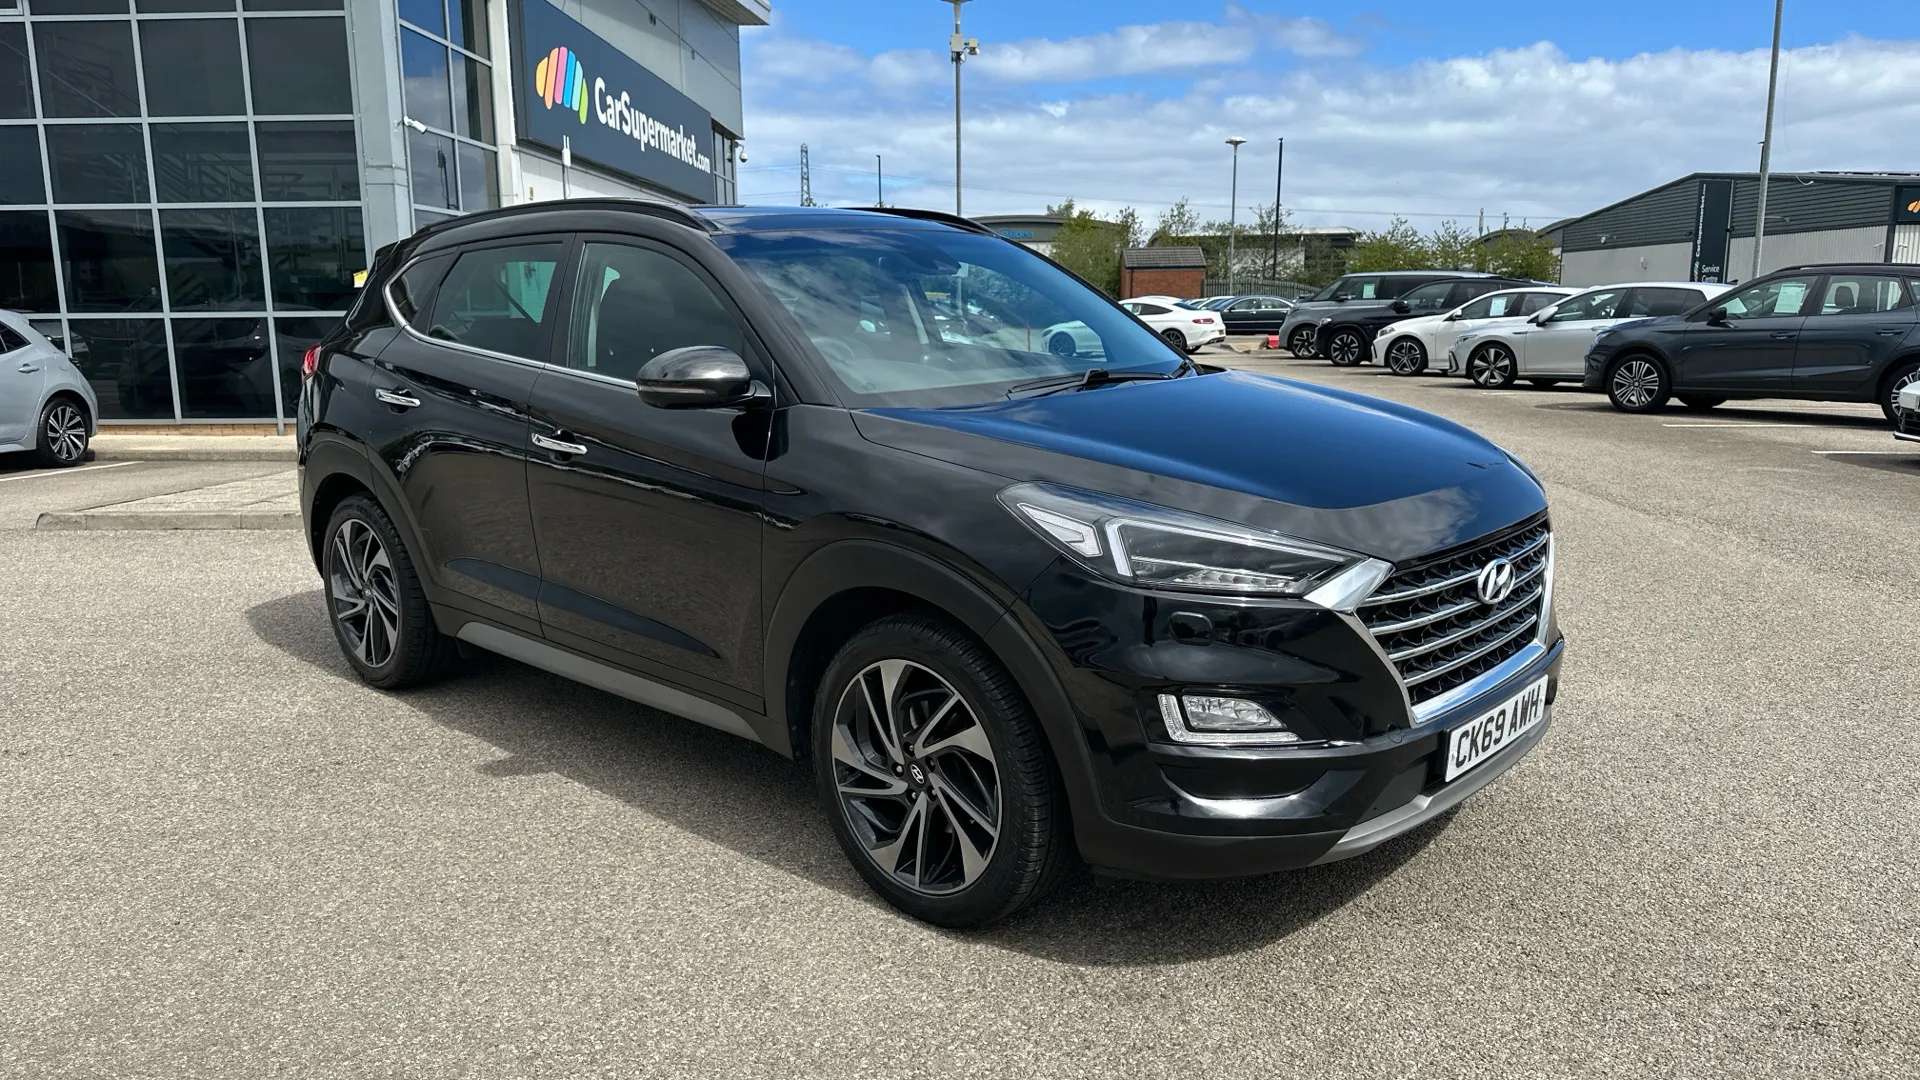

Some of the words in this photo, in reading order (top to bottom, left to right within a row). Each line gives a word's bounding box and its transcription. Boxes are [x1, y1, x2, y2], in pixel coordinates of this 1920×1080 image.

[594, 76, 711, 174] CarSupermarket.com
[1701, 264, 1720, 273] Service
[1456, 708, 1506, 768] CK69
[1508, 684, 1541, 736] AWH
